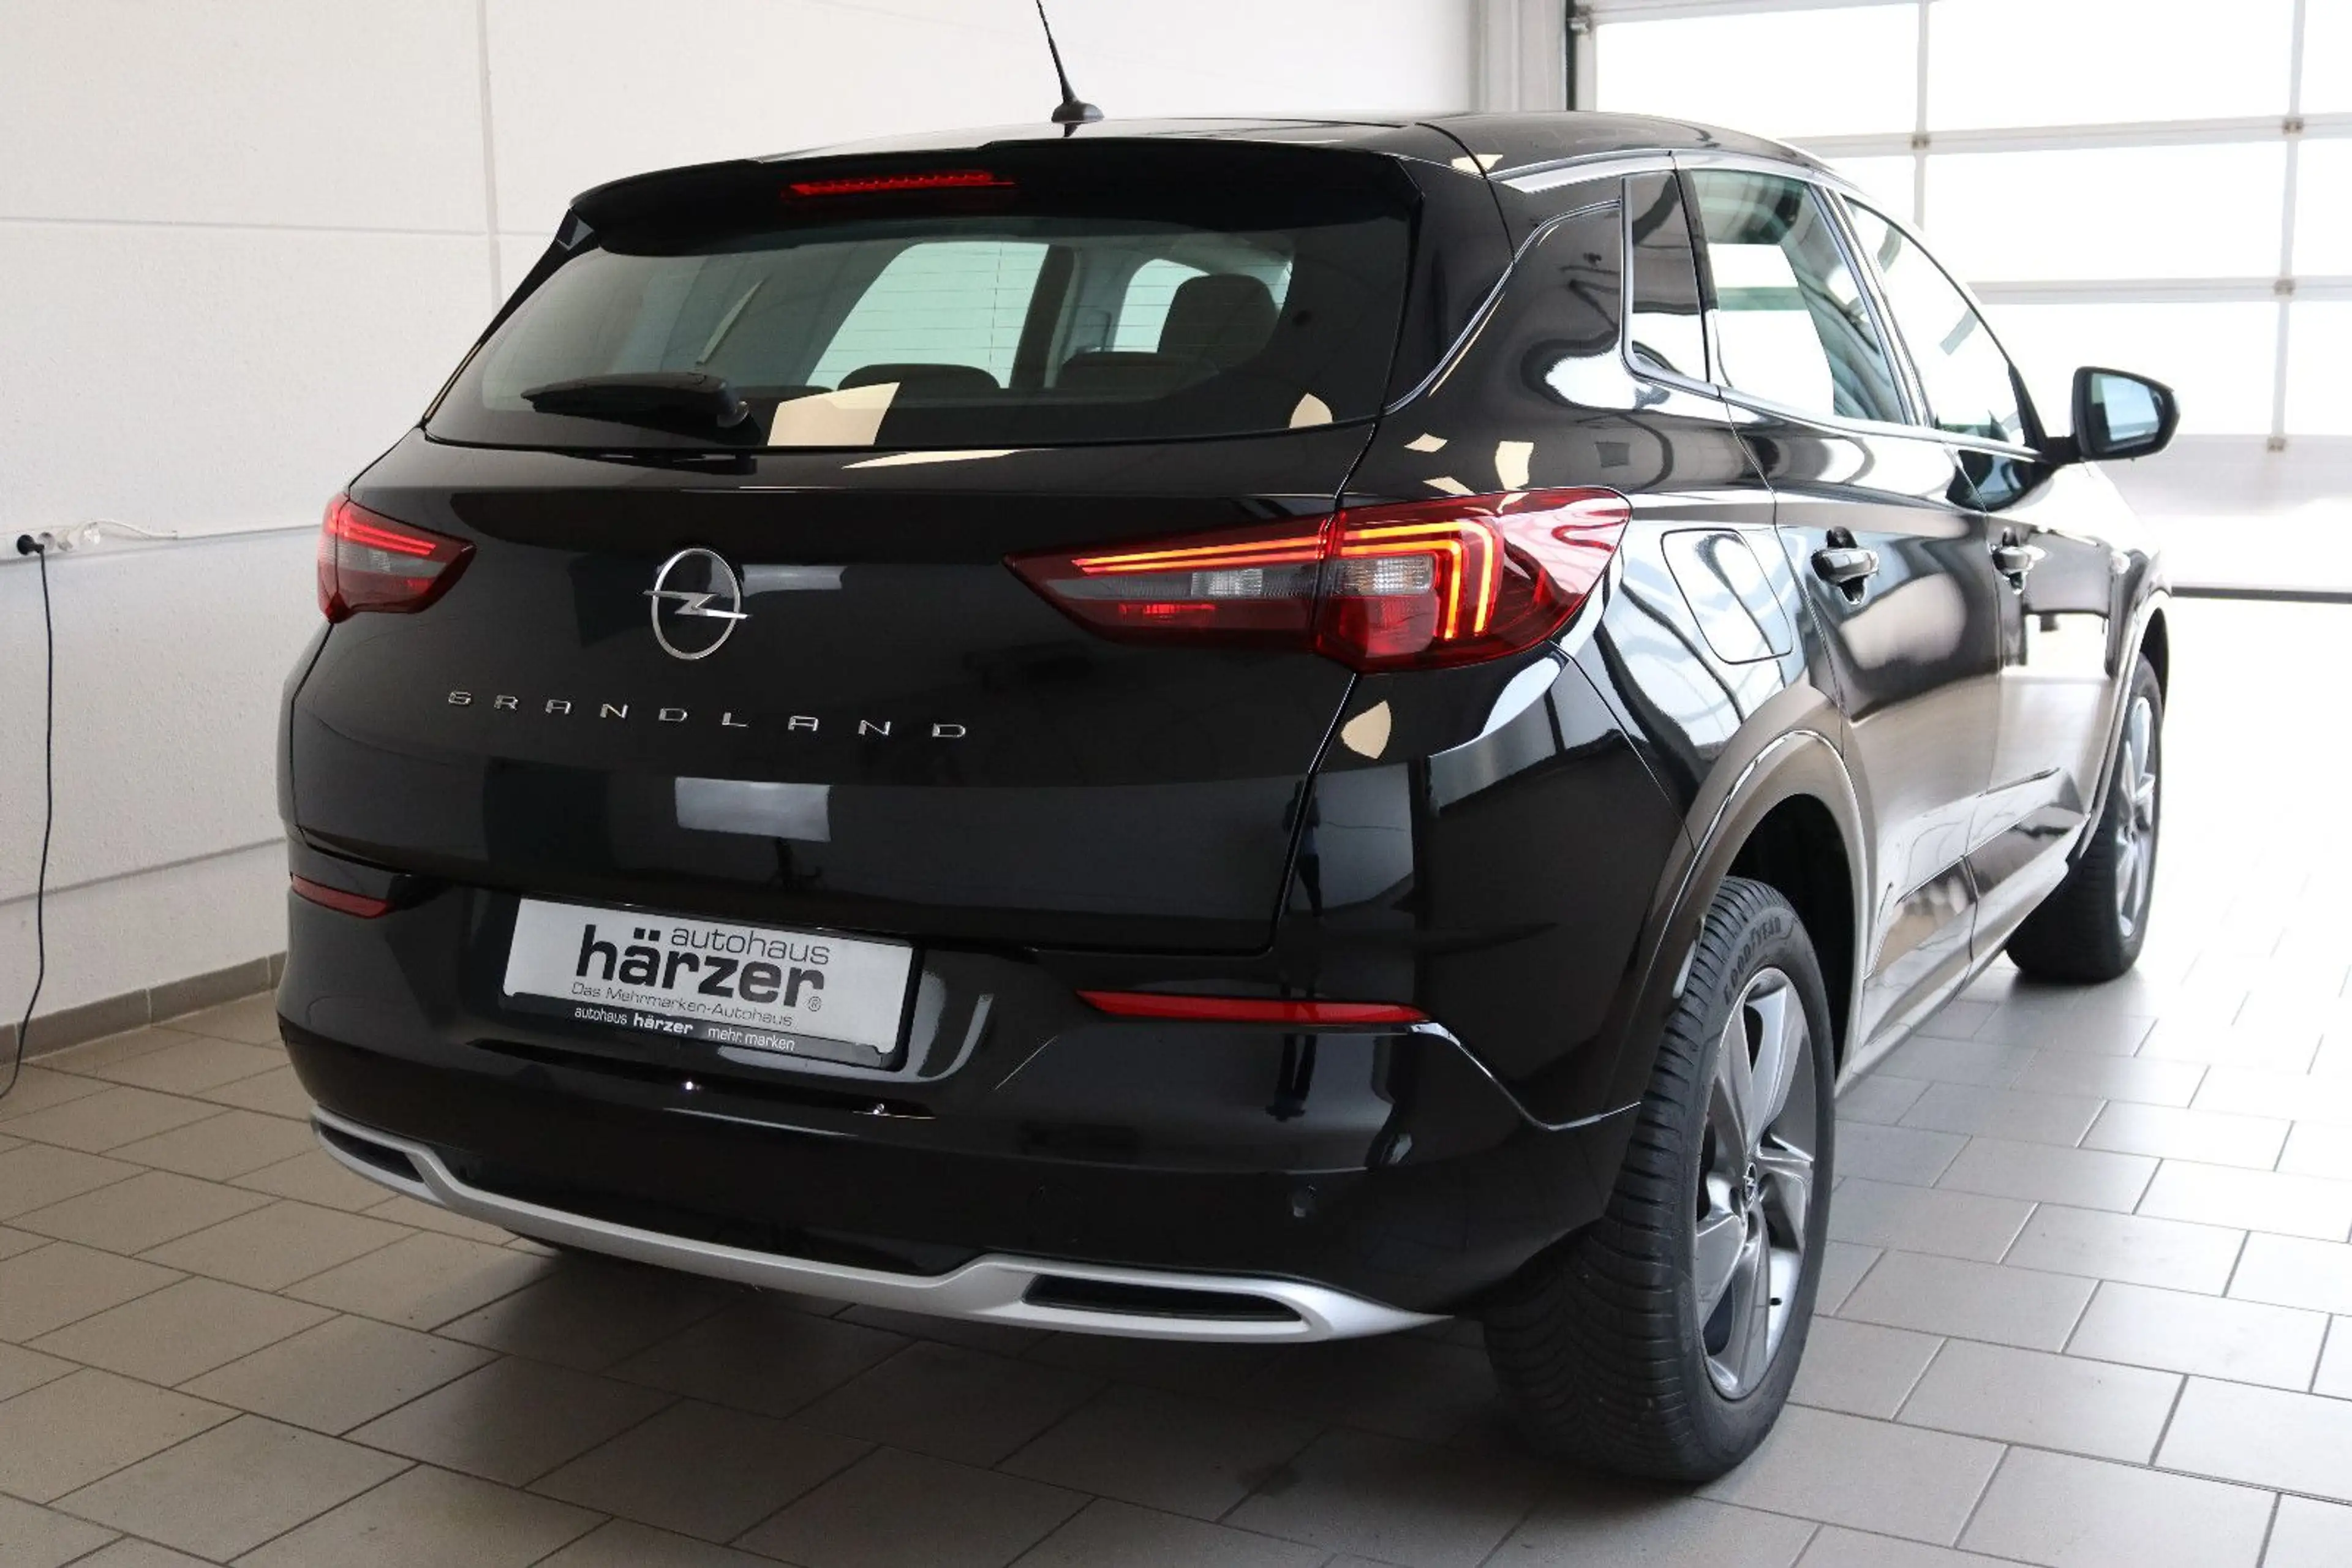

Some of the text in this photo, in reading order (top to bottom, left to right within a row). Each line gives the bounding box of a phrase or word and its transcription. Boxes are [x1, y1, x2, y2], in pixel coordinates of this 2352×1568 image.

[671, 927, 830, 965] autohaus
[571, 982, 601, 998] Das
[575, 1006, 628, 1025] autohaus
[633, 1013, 694, 1036] härzer
[744, 1033, 796, 1052] marken
